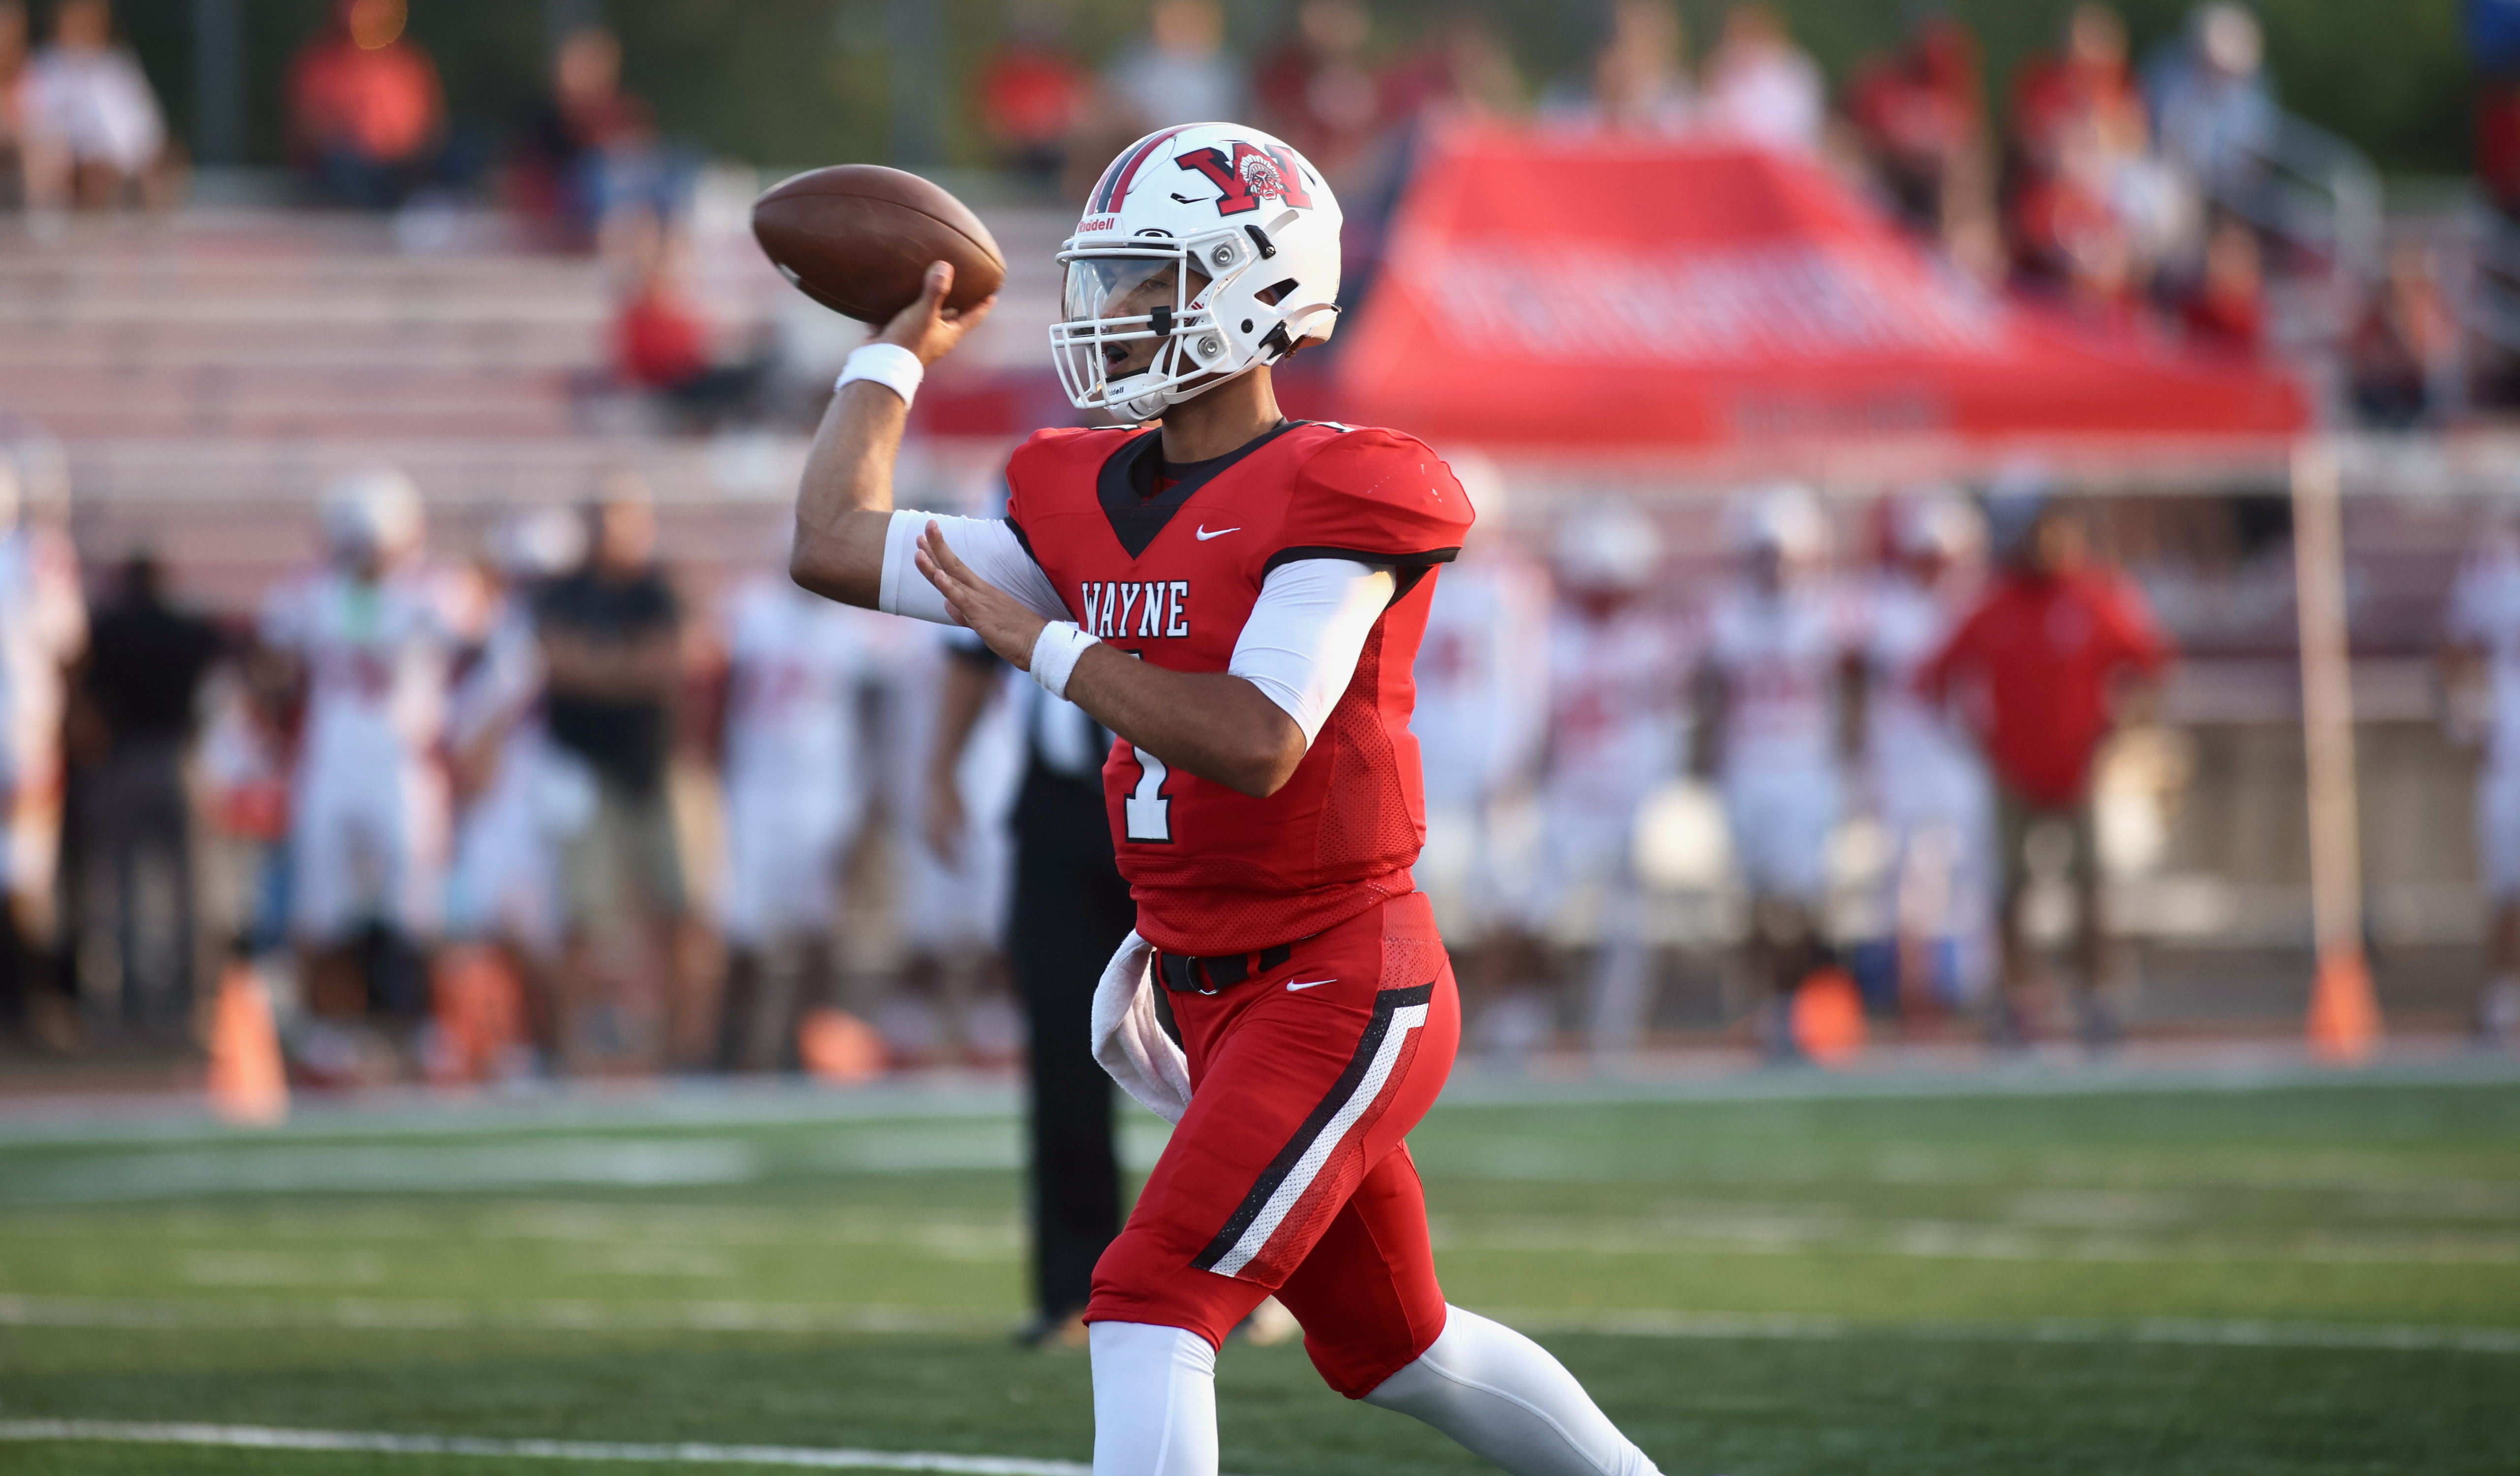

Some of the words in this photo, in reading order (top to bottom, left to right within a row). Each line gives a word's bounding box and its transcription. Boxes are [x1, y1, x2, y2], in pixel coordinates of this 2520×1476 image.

[1174, 142, 1313, 217] W
[1077, 217, 1115, 233] Riddell
[1108, 386, 1124, 396] ddell
[1082, 580, 1189, 639] WAYNE
